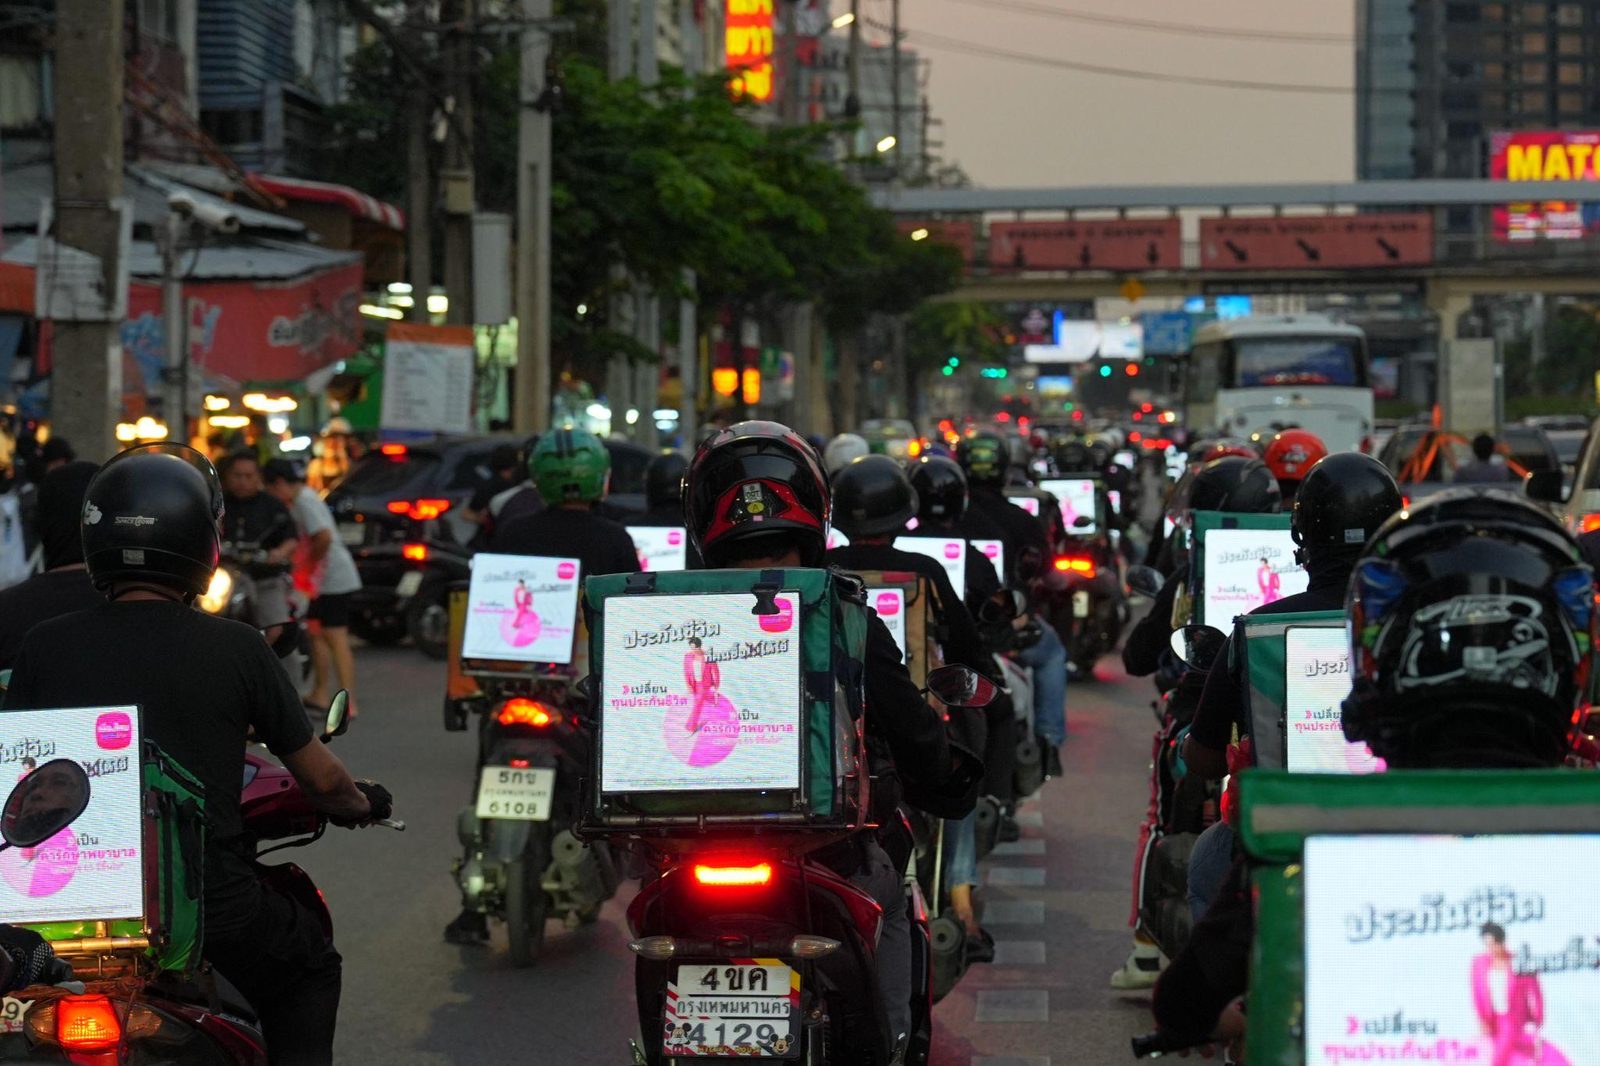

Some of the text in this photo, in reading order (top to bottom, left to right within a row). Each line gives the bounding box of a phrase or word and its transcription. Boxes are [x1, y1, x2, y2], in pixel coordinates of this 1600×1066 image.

[623, 619, 721, 649] ประกันชีวิต
[631, 681, 667, 695] เปลี่ยน
[611, 694, 688, 710] ทุนประกันชีวิต
[738, 708, 759, 720] เป็น
[1313, 706, 1342, 720] เปลี่ย
[488, 801, 537, 815] 6108
[76, 832, 99, 846] เป็น
[1345, 884, 1543, 943] ประกันชีวิต
[700, 967, 768, 991] 4ขค
[5, 1001, 19, 1020] 9
[677, 1000, 791, 1017] กรุงเทพมหานคร
[1364, 1007, 1437, 1034] เปลี่ยน
[688, 1022, 776, 1047] 4129
[1324, 1039, 1479, 1065] ทุนประกันชีวิต
